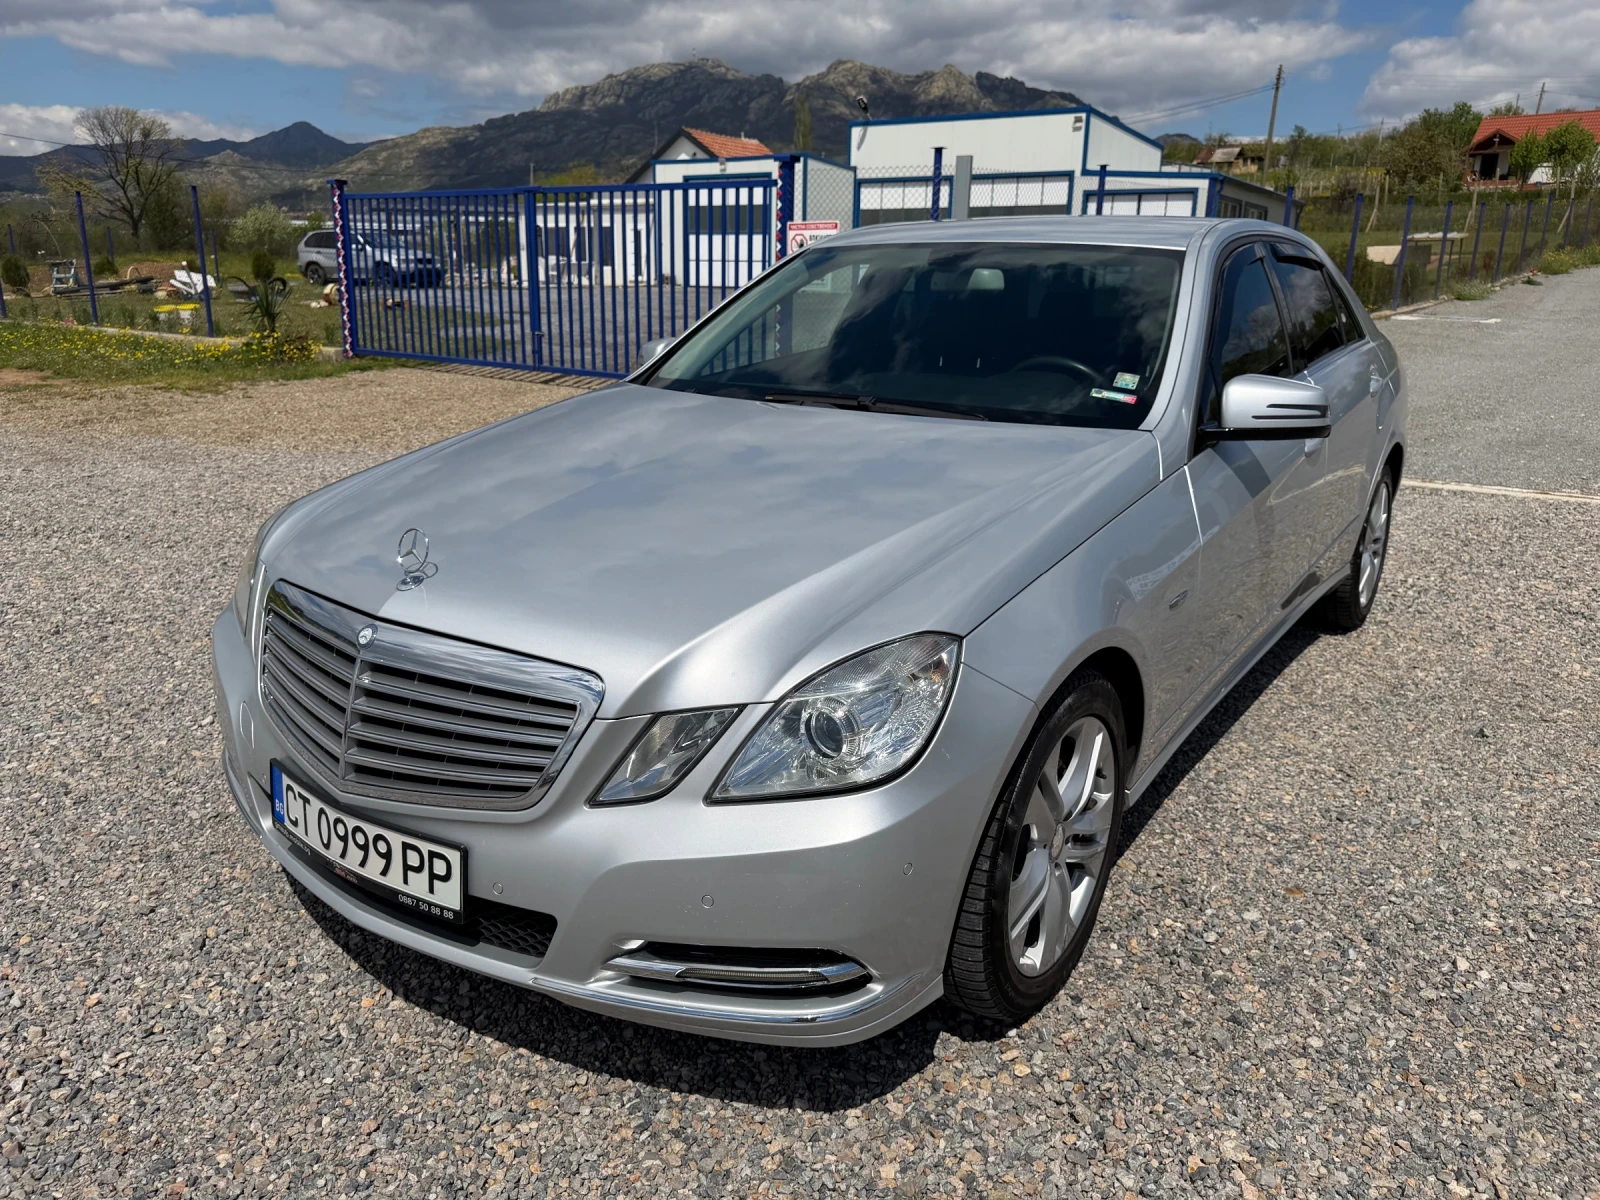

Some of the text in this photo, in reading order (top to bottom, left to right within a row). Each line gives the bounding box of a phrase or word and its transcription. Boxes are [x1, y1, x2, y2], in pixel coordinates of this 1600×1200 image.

[275, 798, 284, 815] BG
[286, 784, 452, 895] CT 0999 PP
[398, 894, 454, 920] 0887 50 88 88
